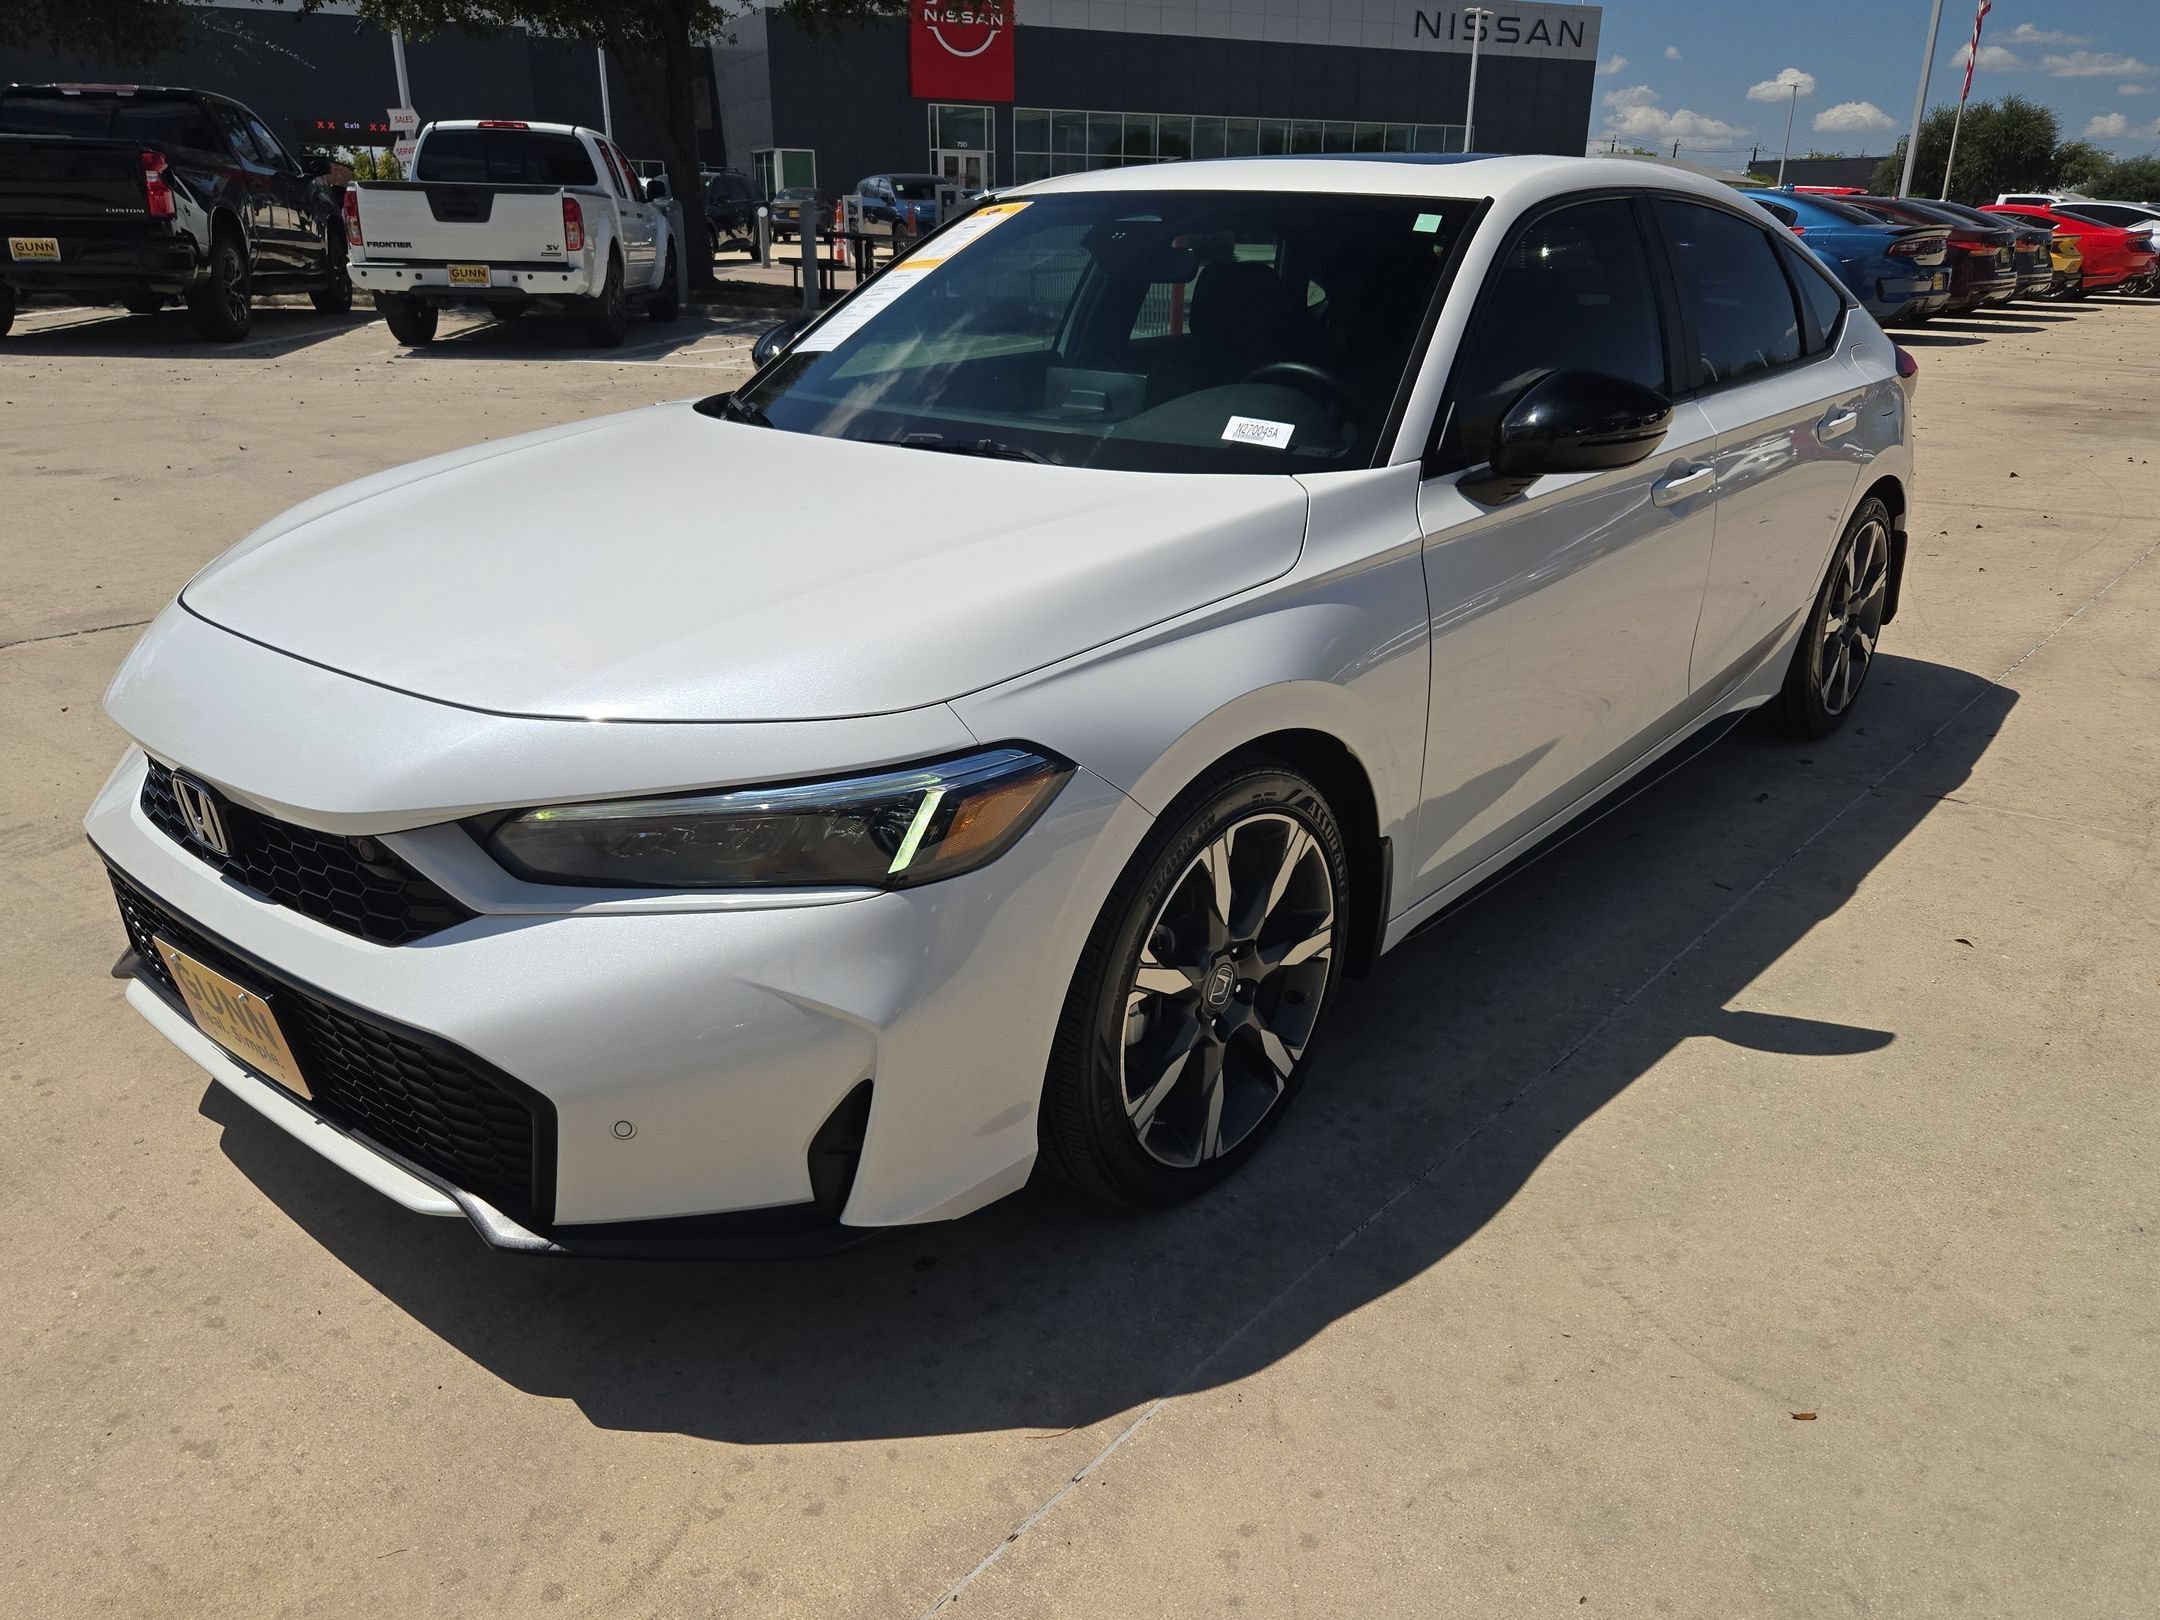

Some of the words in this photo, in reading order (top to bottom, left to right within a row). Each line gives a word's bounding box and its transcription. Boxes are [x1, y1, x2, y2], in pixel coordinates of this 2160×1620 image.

[924, 9, 1003, 26] NISSAN
[1414, 10, 1585, 48] NISSAN
[15, 242, 55, 251] GUNN
[366, 241, 412, 249] FRONTIER
[451, 268, 486, 278] GUNN
[1236, 422, 1279, 439] N270045A
[174, 962, 281, 1050] GUNN
